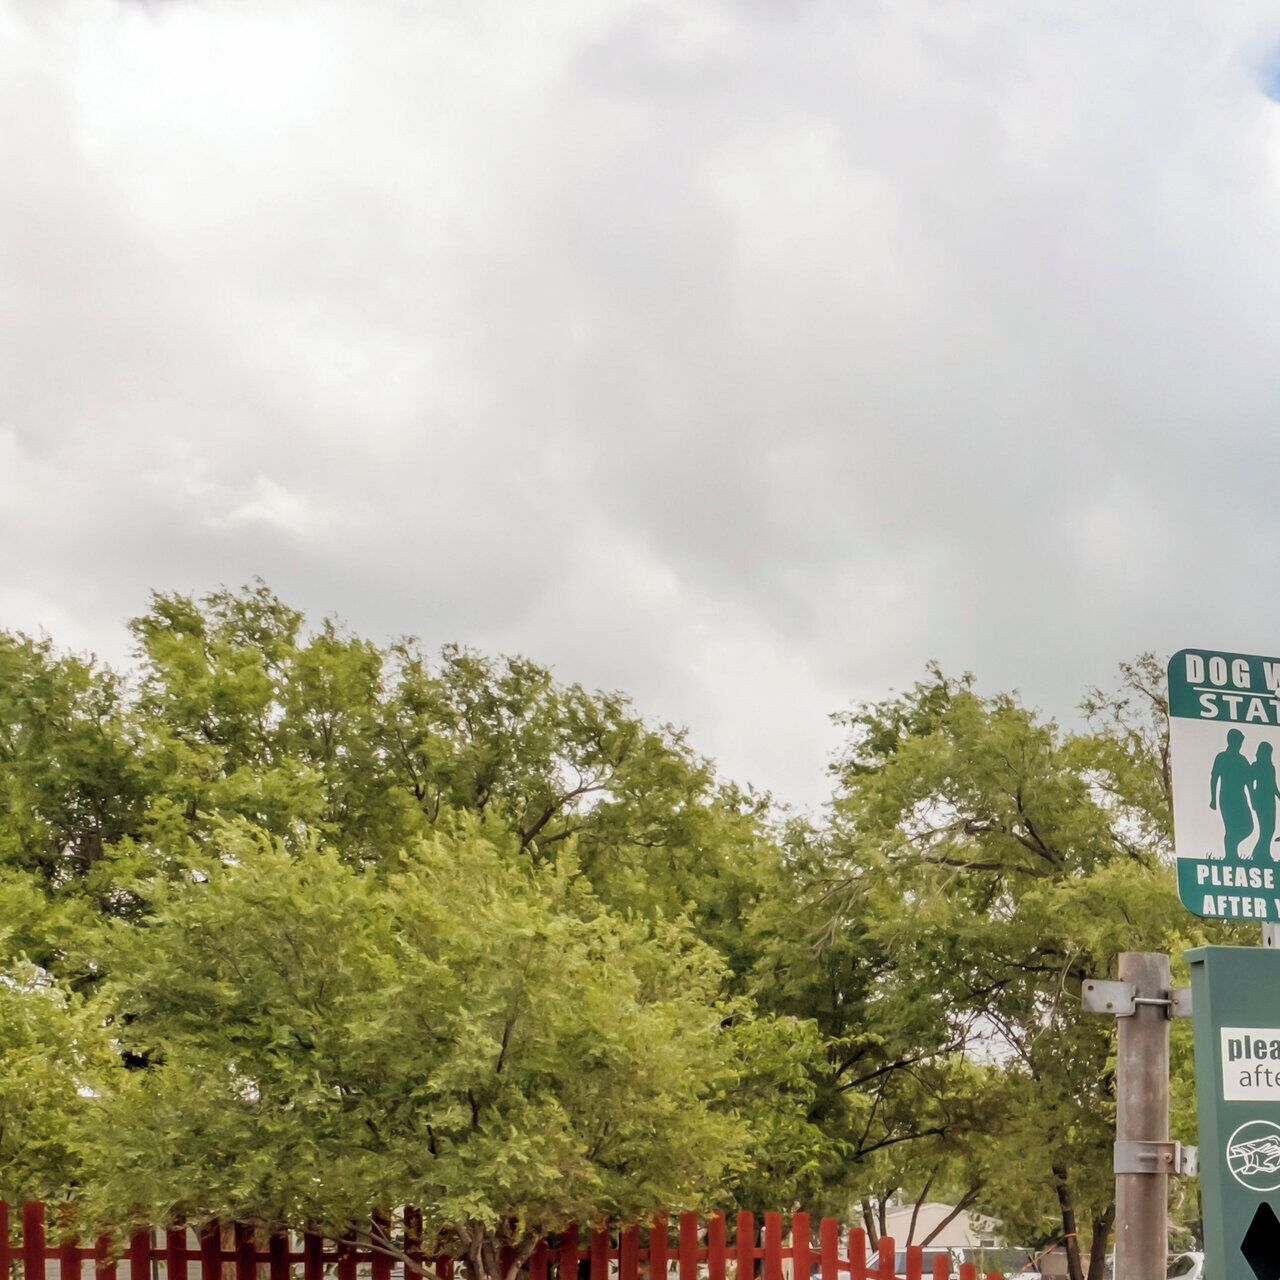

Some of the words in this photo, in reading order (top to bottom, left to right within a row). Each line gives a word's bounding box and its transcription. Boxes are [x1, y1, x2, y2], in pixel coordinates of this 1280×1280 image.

[1185, 653, 1250, 688] DOG
[1196, 864, 1275, 889] PLEASE
[1202, 894, 1267, 918] AFTER
